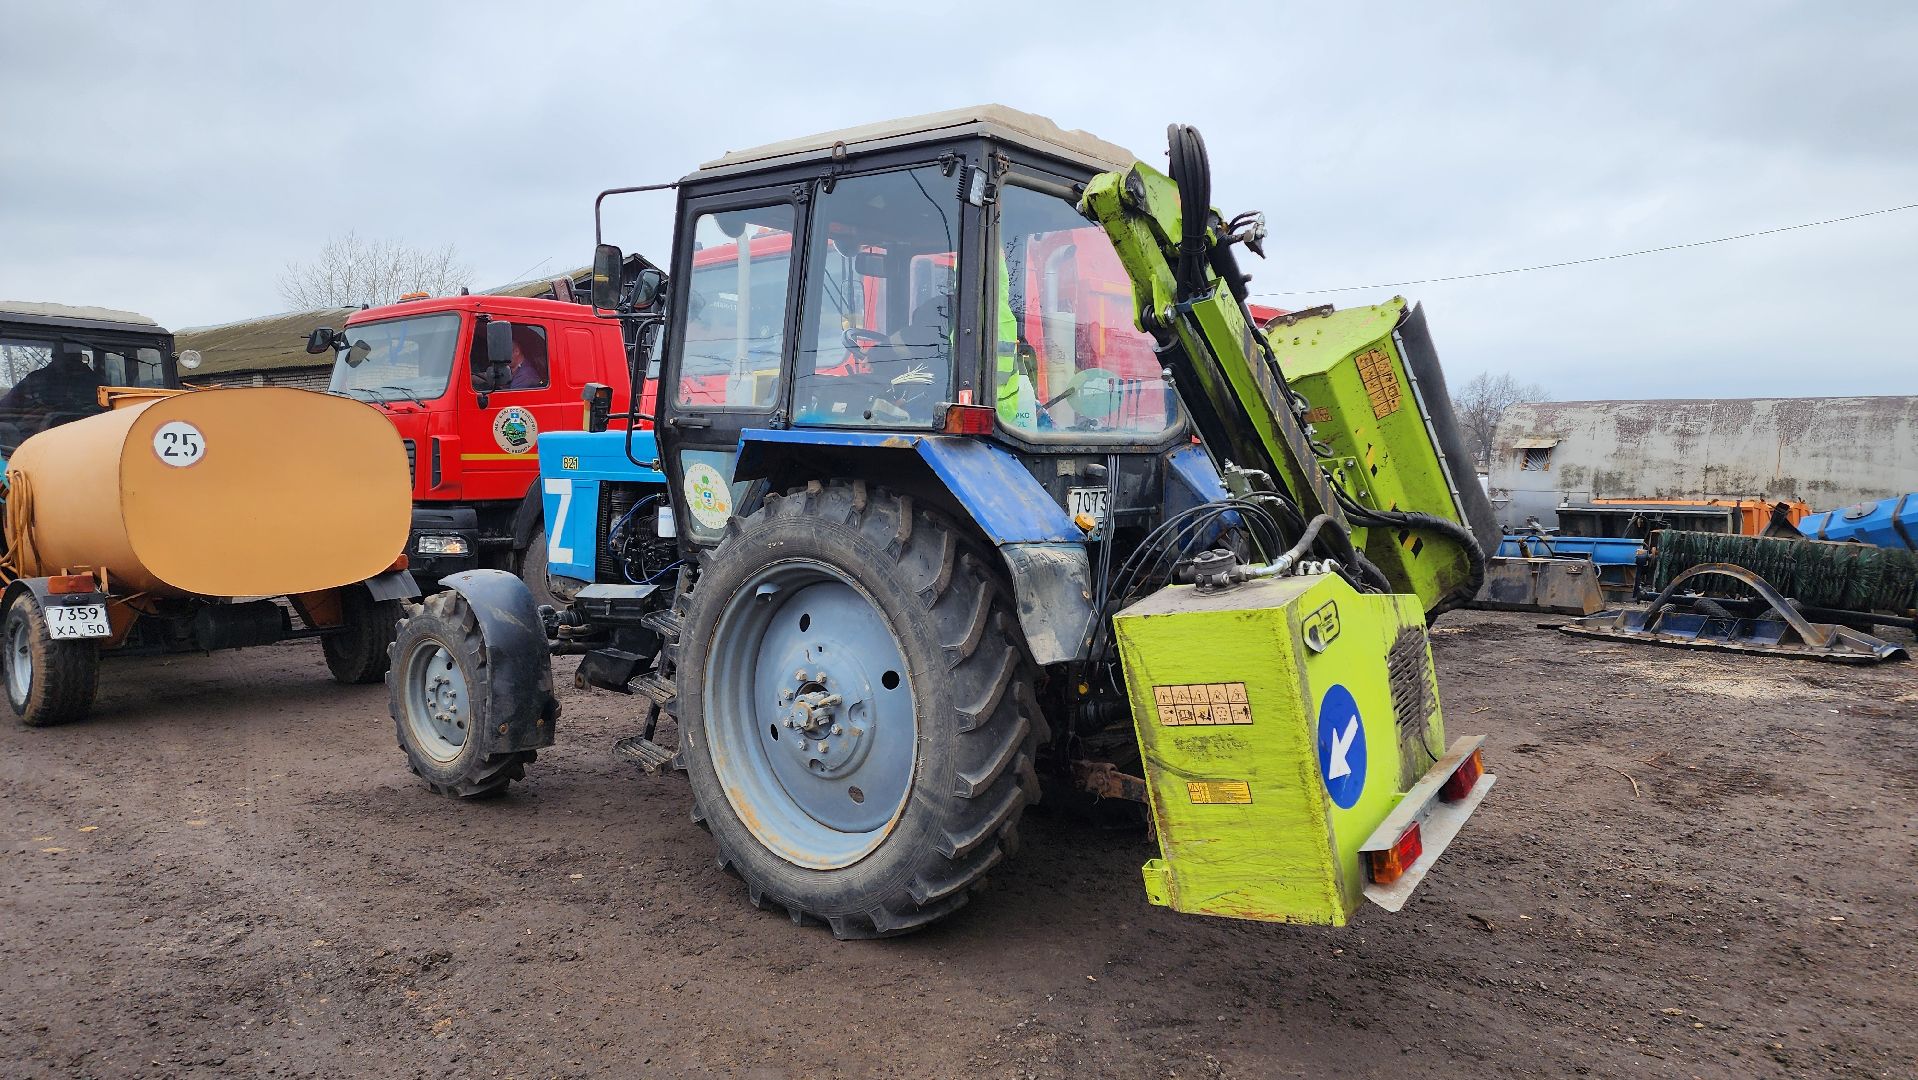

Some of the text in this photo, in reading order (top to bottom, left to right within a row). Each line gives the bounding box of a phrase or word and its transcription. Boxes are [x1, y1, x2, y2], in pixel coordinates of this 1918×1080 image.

[163, 432, 198, 457] 25
[1073, 490, 1107, 514] 7073
[544, 478, 573, 564] Z
[55, 607, 99, 621] 7359
[56, 624, 105, 636] ХА 50
